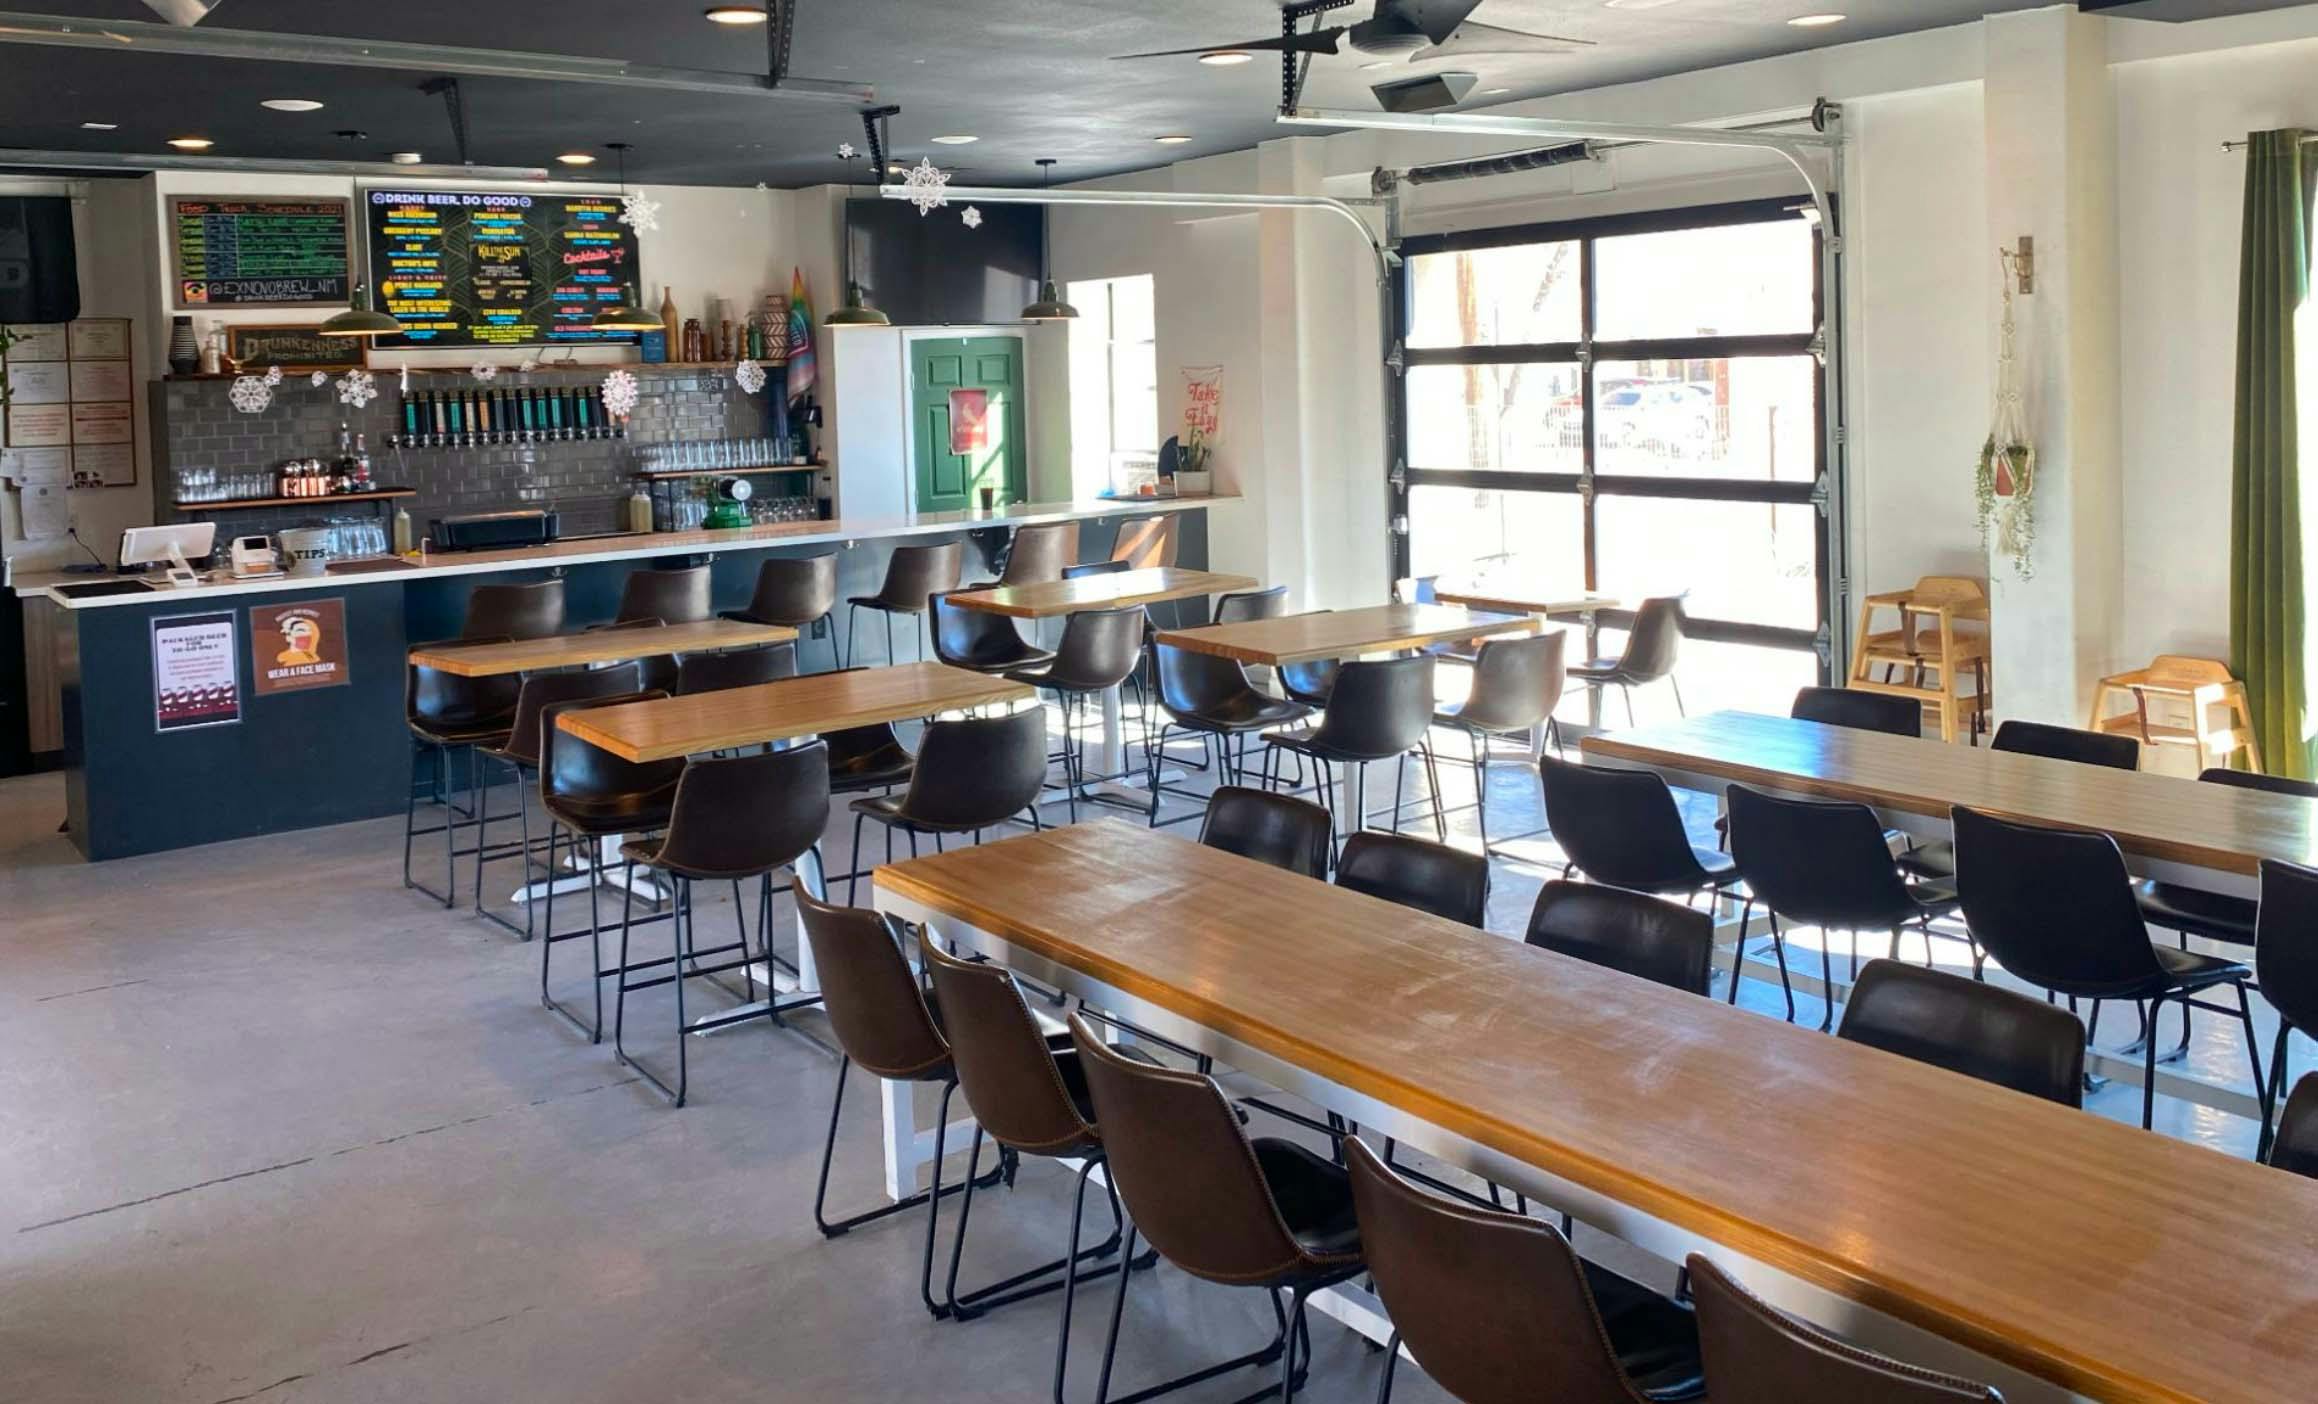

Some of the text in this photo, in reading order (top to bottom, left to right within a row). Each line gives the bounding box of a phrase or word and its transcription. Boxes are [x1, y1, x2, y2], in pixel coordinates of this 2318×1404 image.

[386, 194, 425, 203] DRINK
[463, 196, 480, 205] DO
[483, 196, 518, 206] GOOD
[563, 249, 610, 264] Cocktails
[296, 549, 325, 559] TIPS
[267, 662, 336, 679] WEAR A FACE MASK
